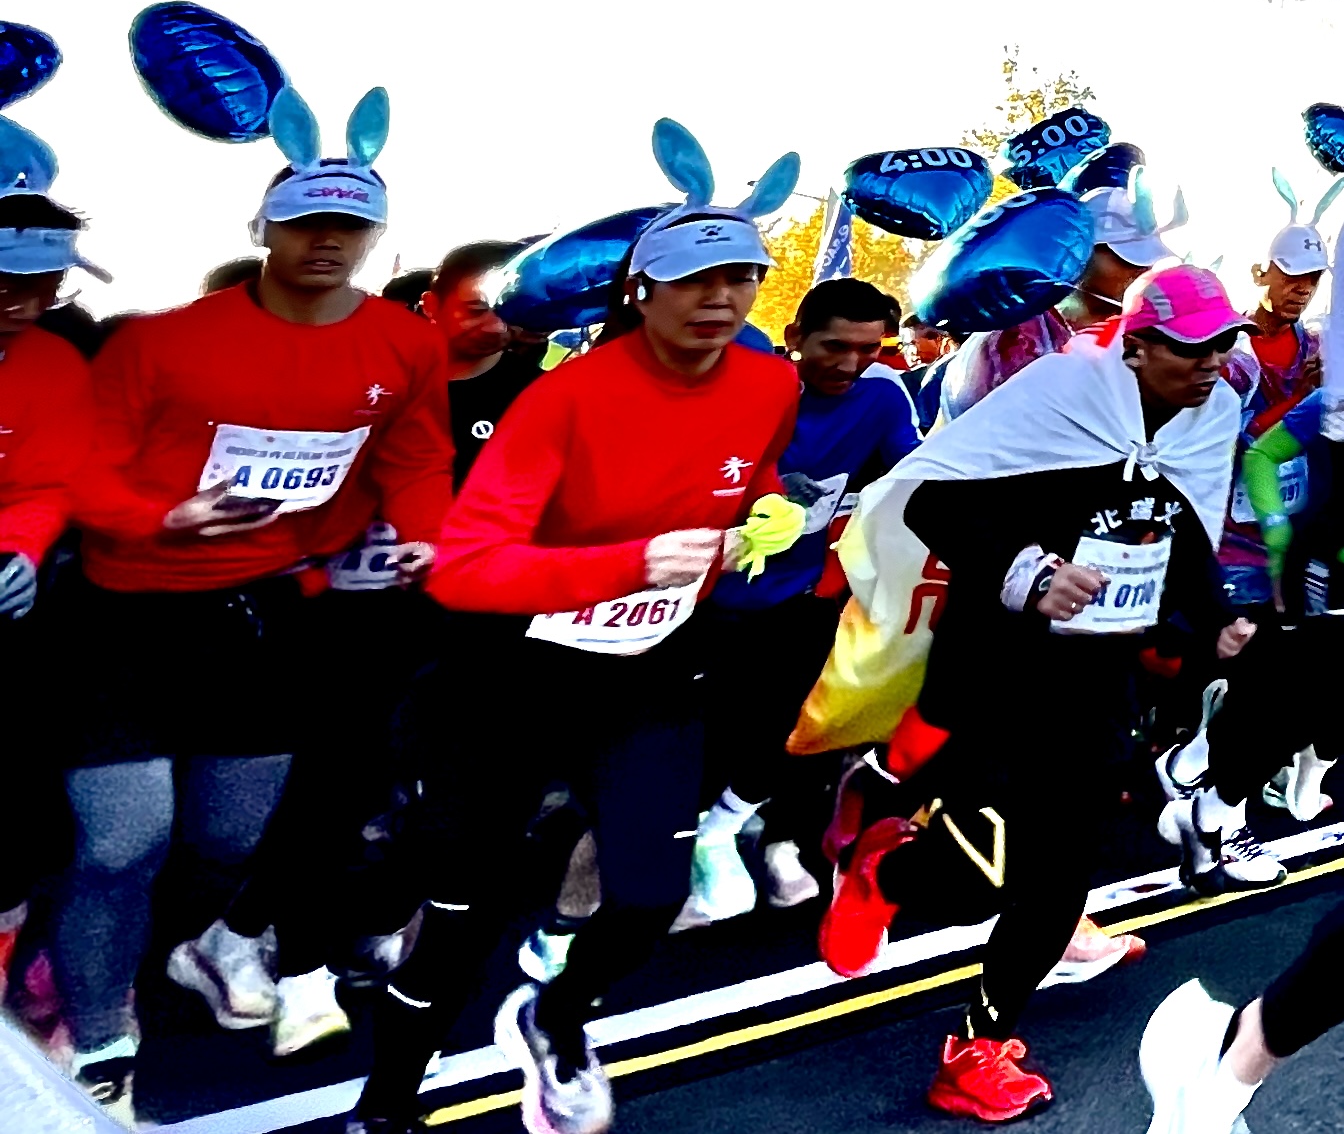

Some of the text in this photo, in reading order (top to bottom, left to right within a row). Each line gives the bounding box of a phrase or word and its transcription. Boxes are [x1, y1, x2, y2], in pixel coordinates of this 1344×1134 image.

[1011, 115, 1089, 167] 5:00
[880, 148, 973, 174] 4:00
[260, 464, 341, 490] 0693
[602, 597, 683, 627] 2061
